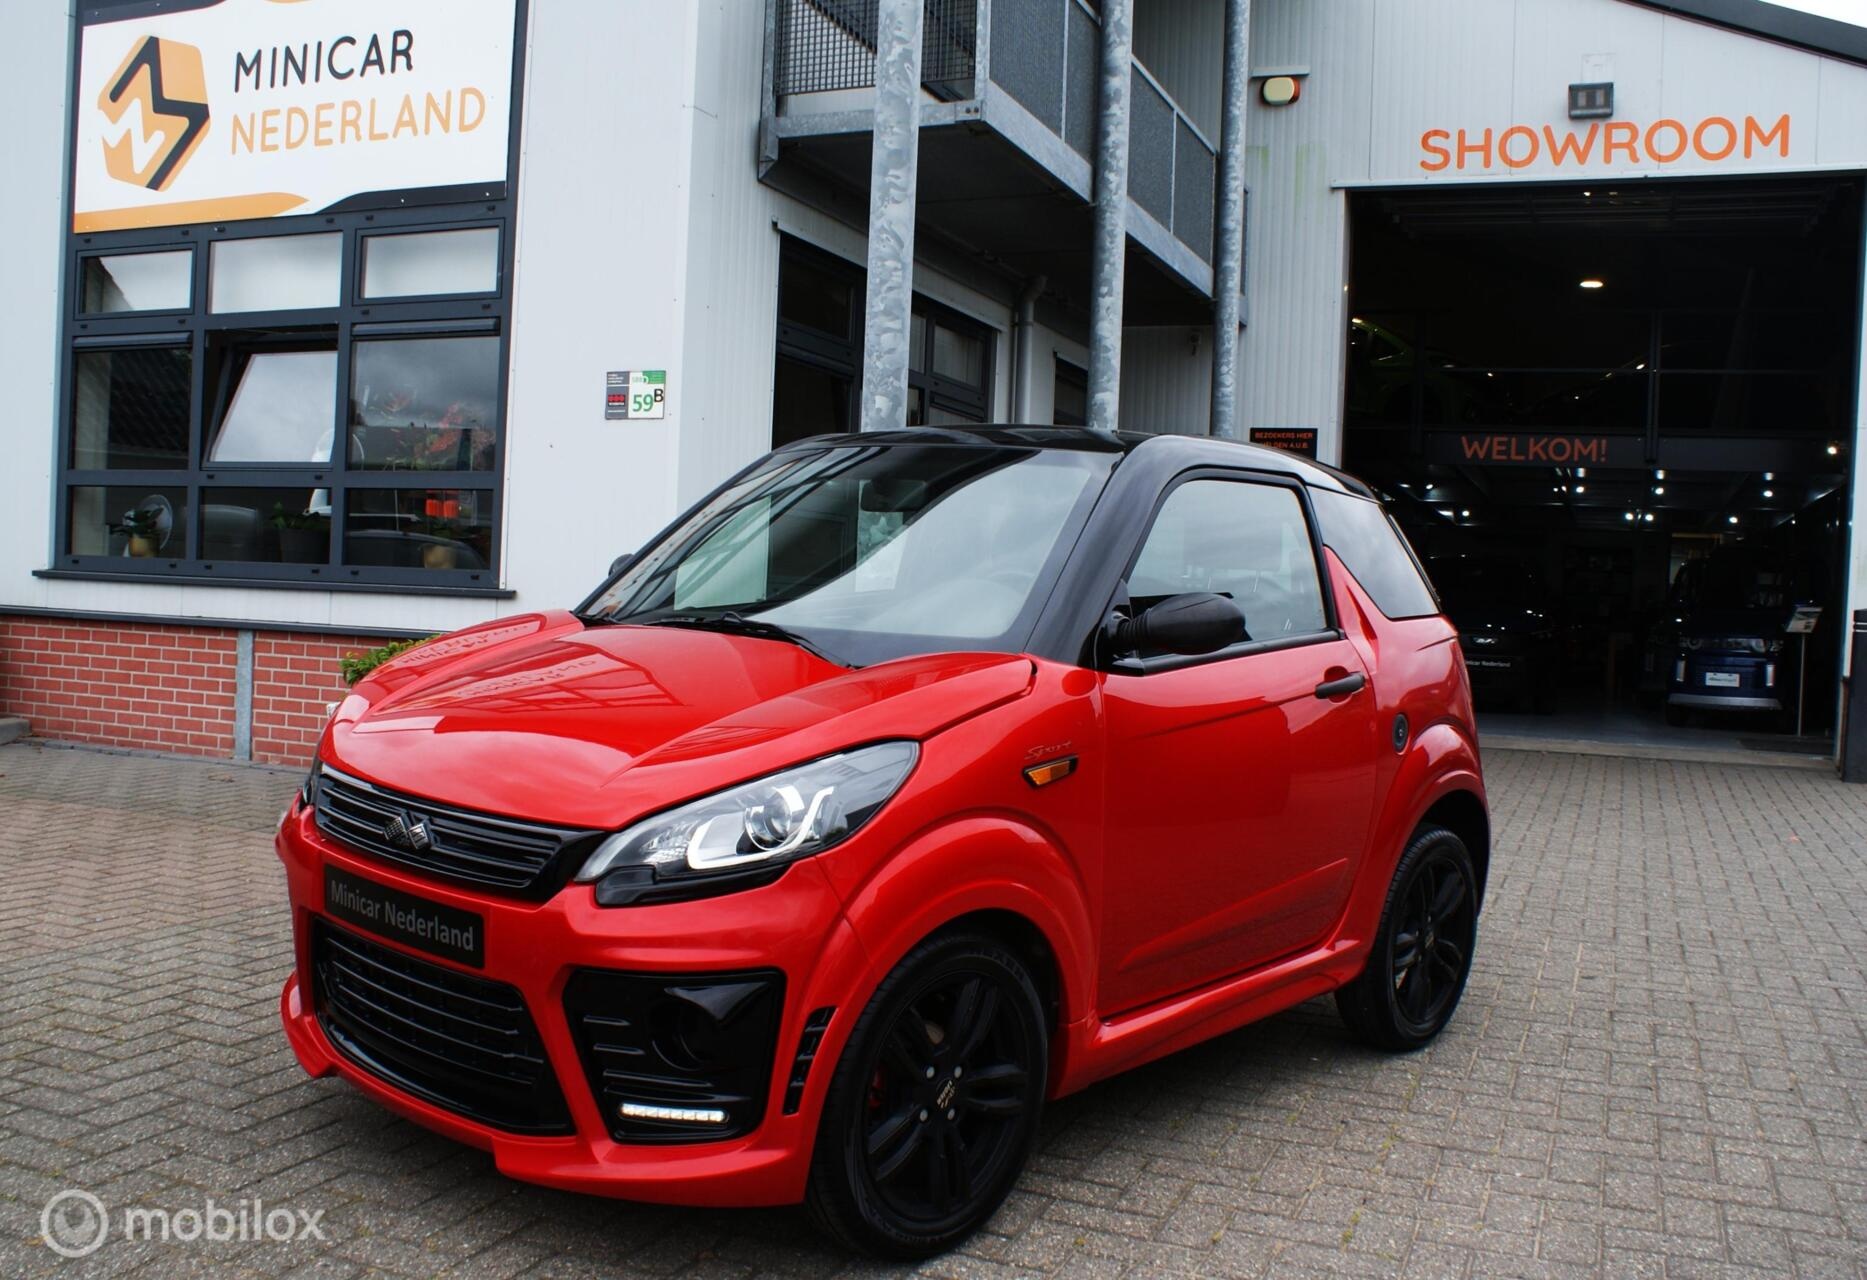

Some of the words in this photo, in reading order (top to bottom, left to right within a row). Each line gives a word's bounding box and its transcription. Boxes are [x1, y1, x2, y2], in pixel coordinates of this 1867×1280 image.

[234, 29, 414, 93] MINICAR
[231, 86, 486, 155] NEDERLAND
[1419, 113, 1791, 172] SHOWROOM
[632, 393, 654, 413] 59
[653, 388, 664, 403] B
[1460, 435, 1608, 463] WELKOM!
[330, 879, 381, 919] Minicar
[384, 900, 475, 952] Nederland
